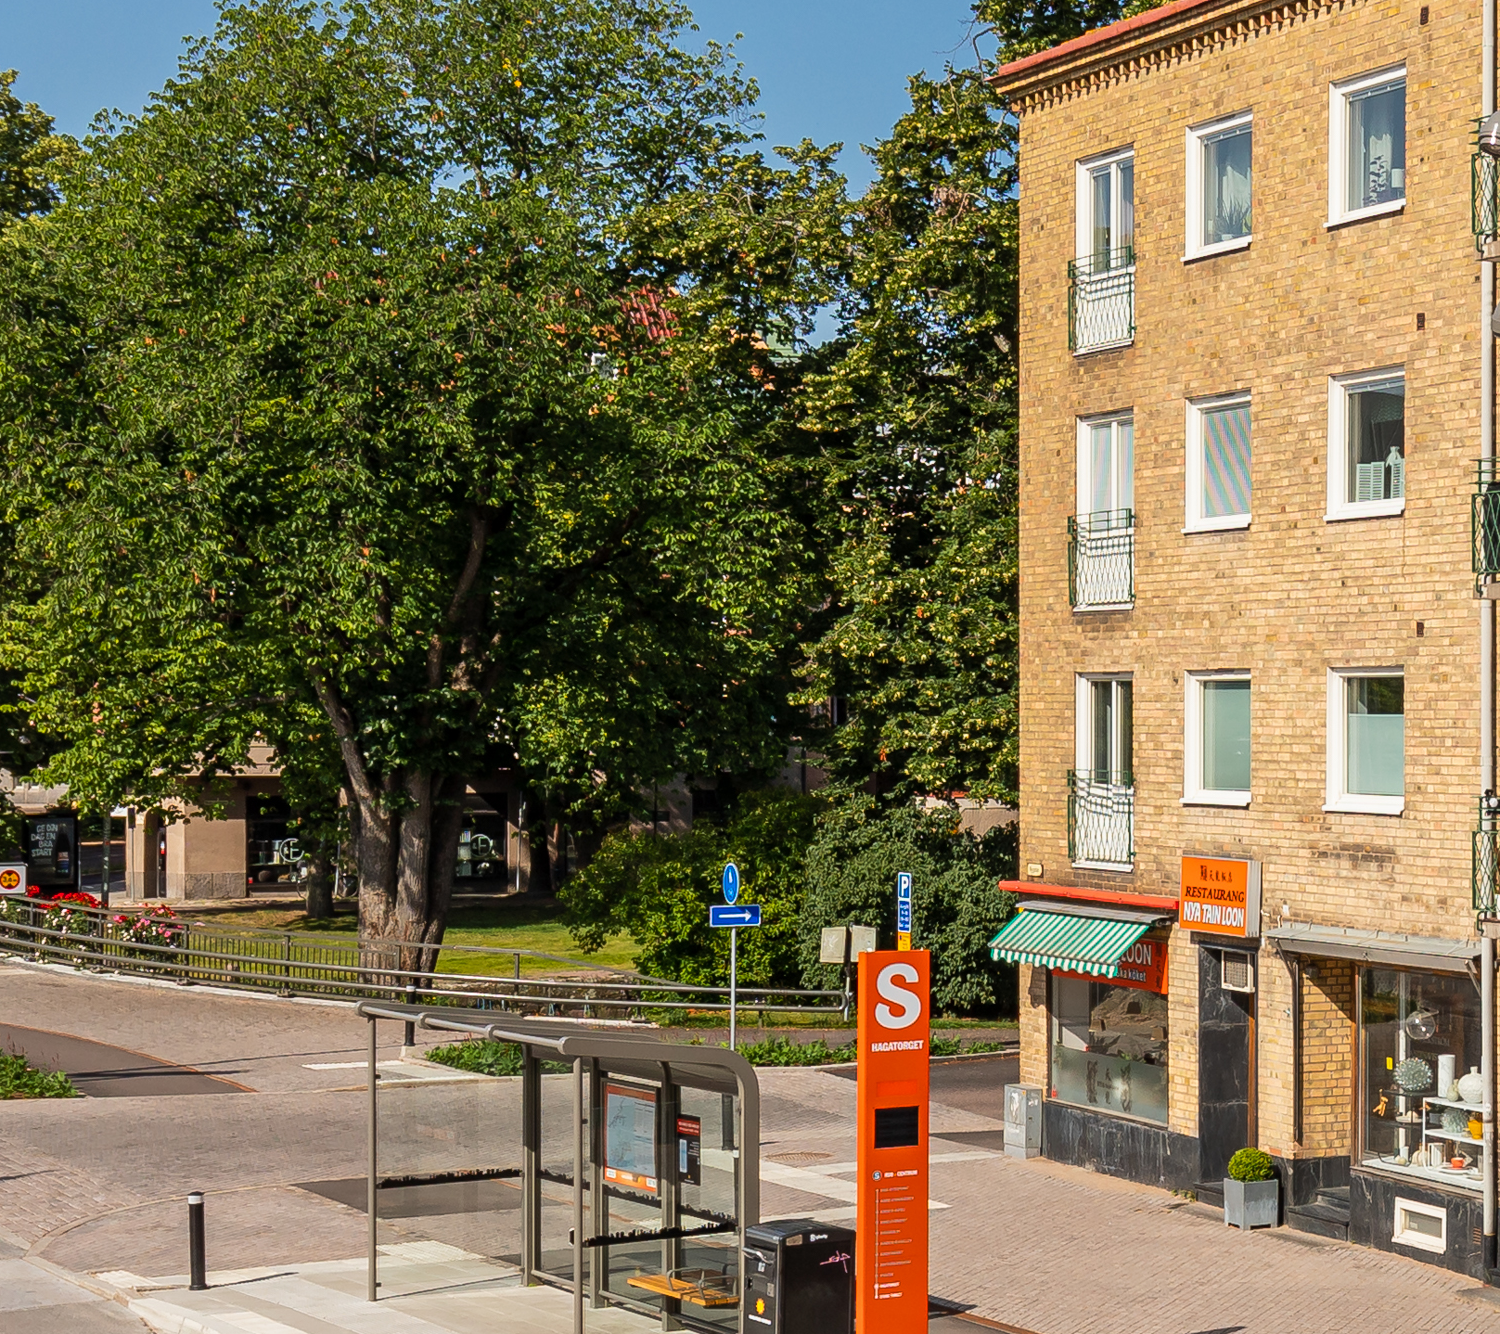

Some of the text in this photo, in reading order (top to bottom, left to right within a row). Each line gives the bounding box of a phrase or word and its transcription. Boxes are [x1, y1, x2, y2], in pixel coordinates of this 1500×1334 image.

[901, 876, 909, 897] P
[1185, 886, 1244, 902] RESTAURANG
[1183, 901, 1244, 927] NYA TAIN LOON
[1121, 942, 1152, 966] OON
[875, 963, 921, 1029] S
[871, 1040, 924, 1052] HAGATORGET
